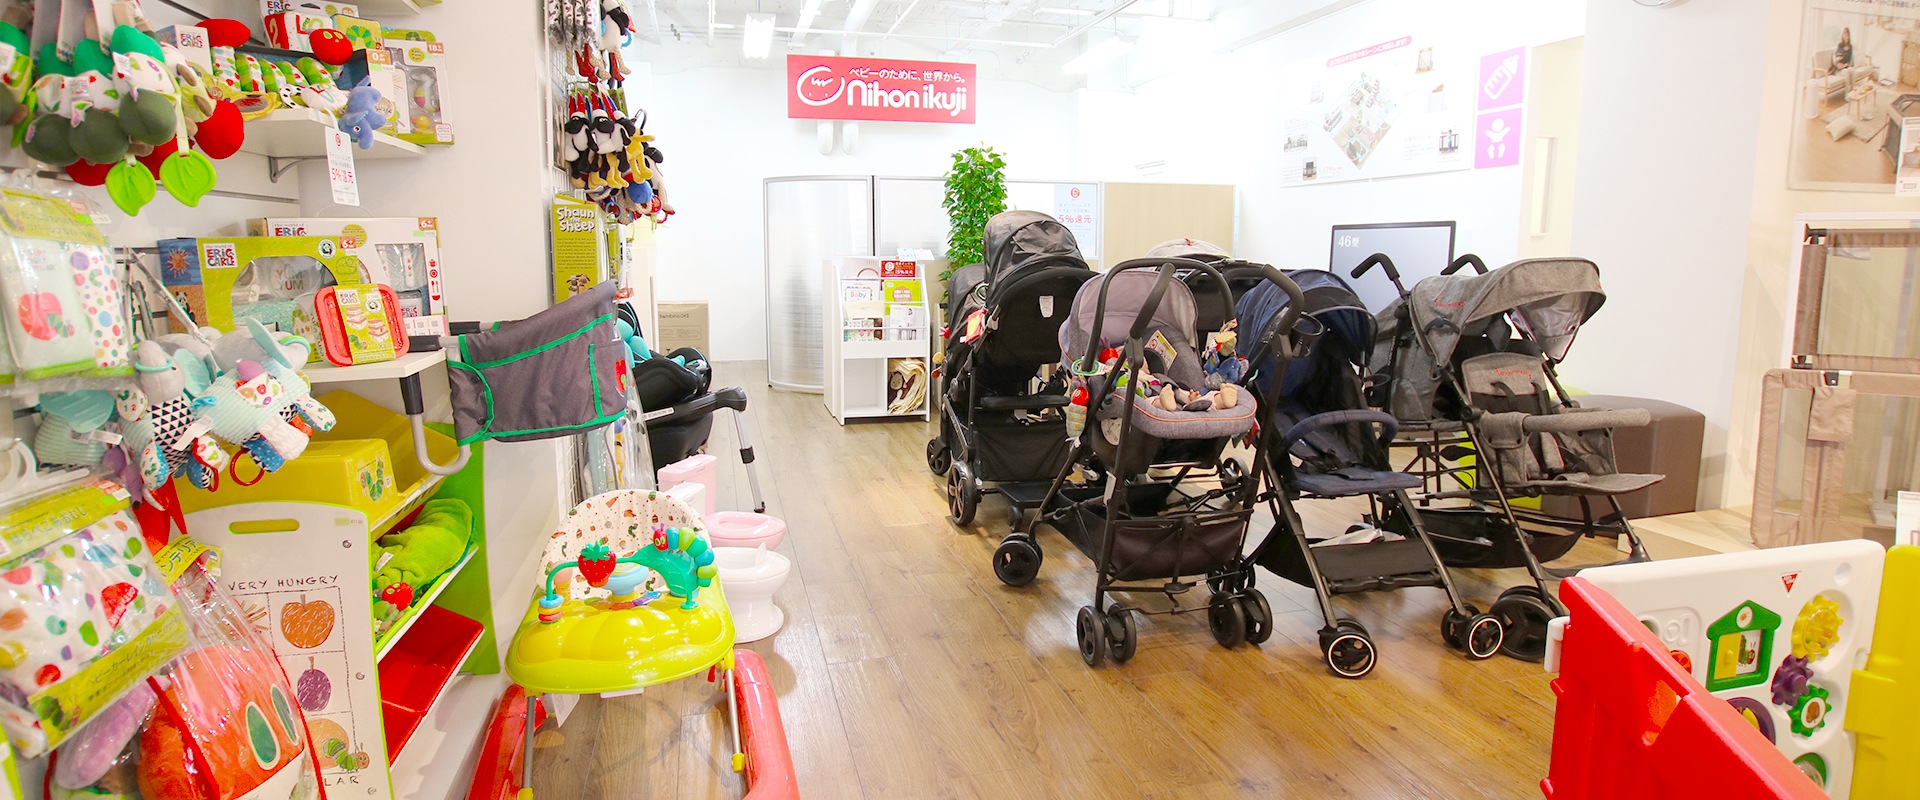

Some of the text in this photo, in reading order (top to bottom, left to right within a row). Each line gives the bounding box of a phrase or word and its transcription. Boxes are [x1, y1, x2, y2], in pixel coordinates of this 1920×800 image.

[180, 33, 203, 42] ERIC
[849, 67, 966, 83] ベビーのために、世界から。
[922, 84, 967, 117] ikuji
[556, 206, 595, 221] Shaun
[275, 227, 307, 237] ERIC
[559, 219, 595, 233] Sheep
[1337, 235, 1360, 248] 46型
[206, 248, 235, 259] ERIC
[207, 256, 236, 267] CARLE
[228, 575, 338, 591] VERY HUNGRY
